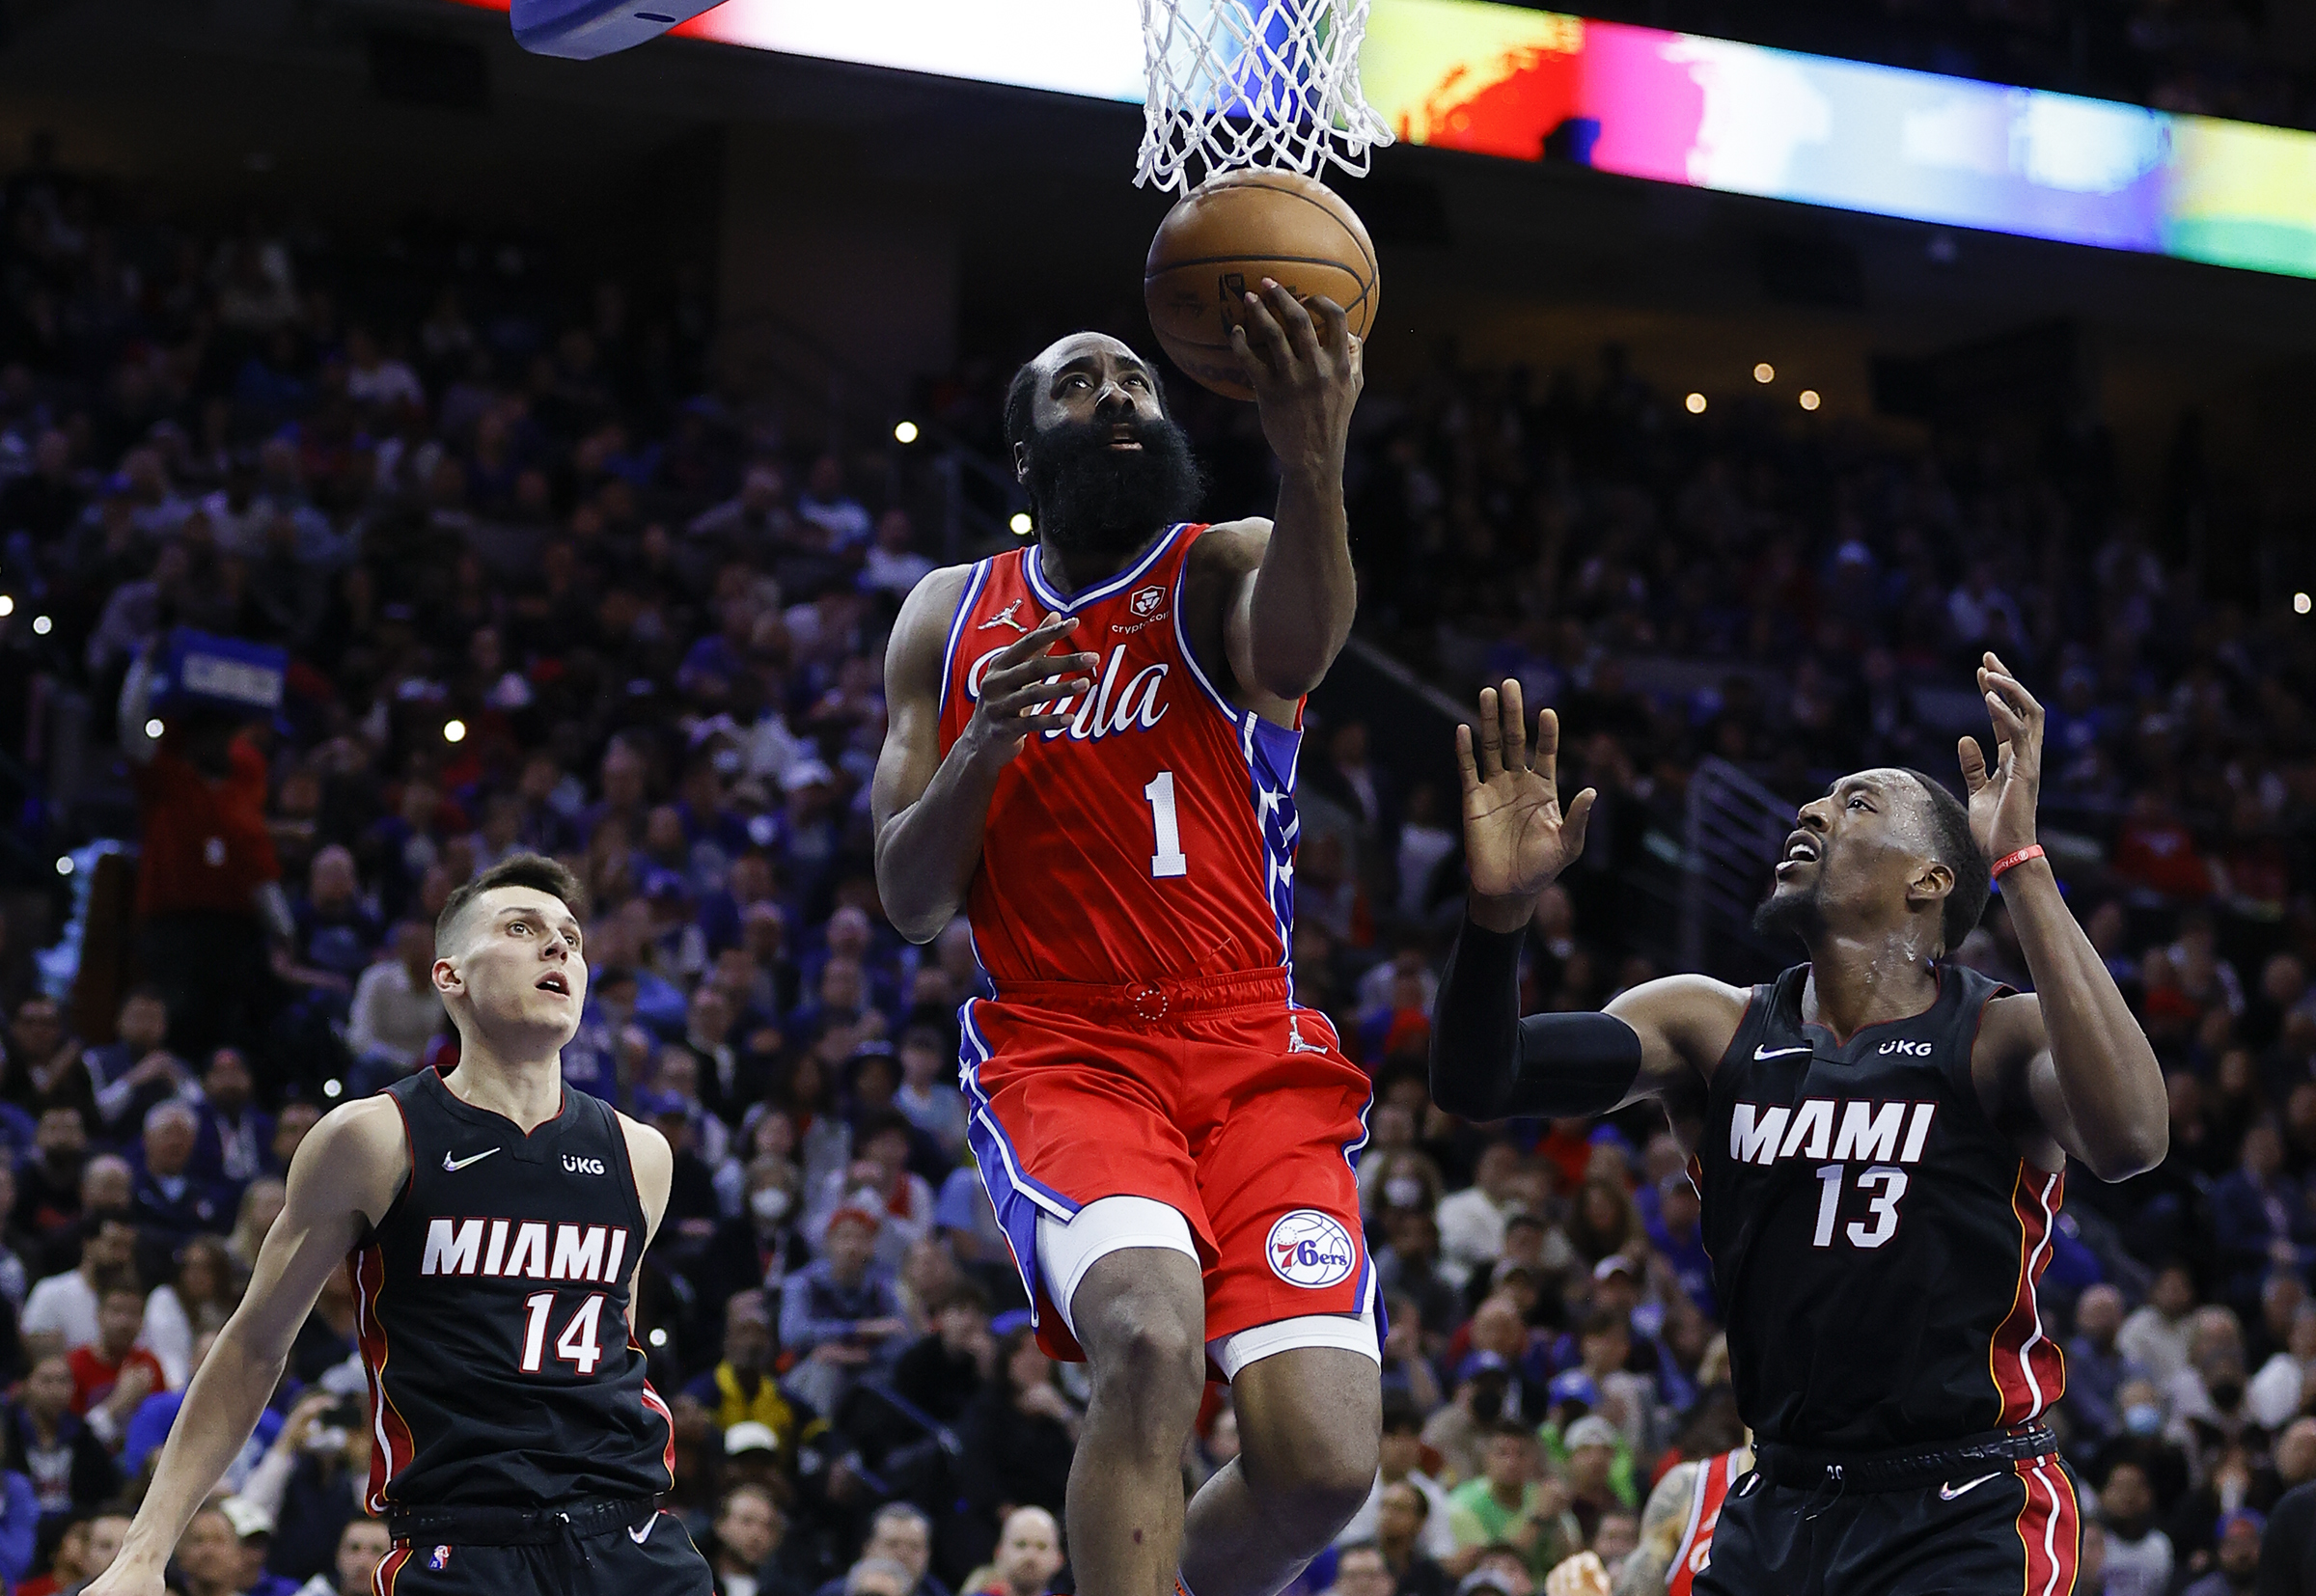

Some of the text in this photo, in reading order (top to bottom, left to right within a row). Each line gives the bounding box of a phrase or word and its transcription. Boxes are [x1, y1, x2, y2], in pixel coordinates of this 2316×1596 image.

[1111, 610, 1171, 635] cryptcom
[1144, 771, 1187, 877] 1
[1729, 1099, 1936, 1166] MAMI
[1812, 1164, 1909, 1249] 13
[421, 1218, 628, 1283] MIAMI
[1277, 1240, 1348, 1270] 76ers
[518, 1291, 605, 1374] 14
